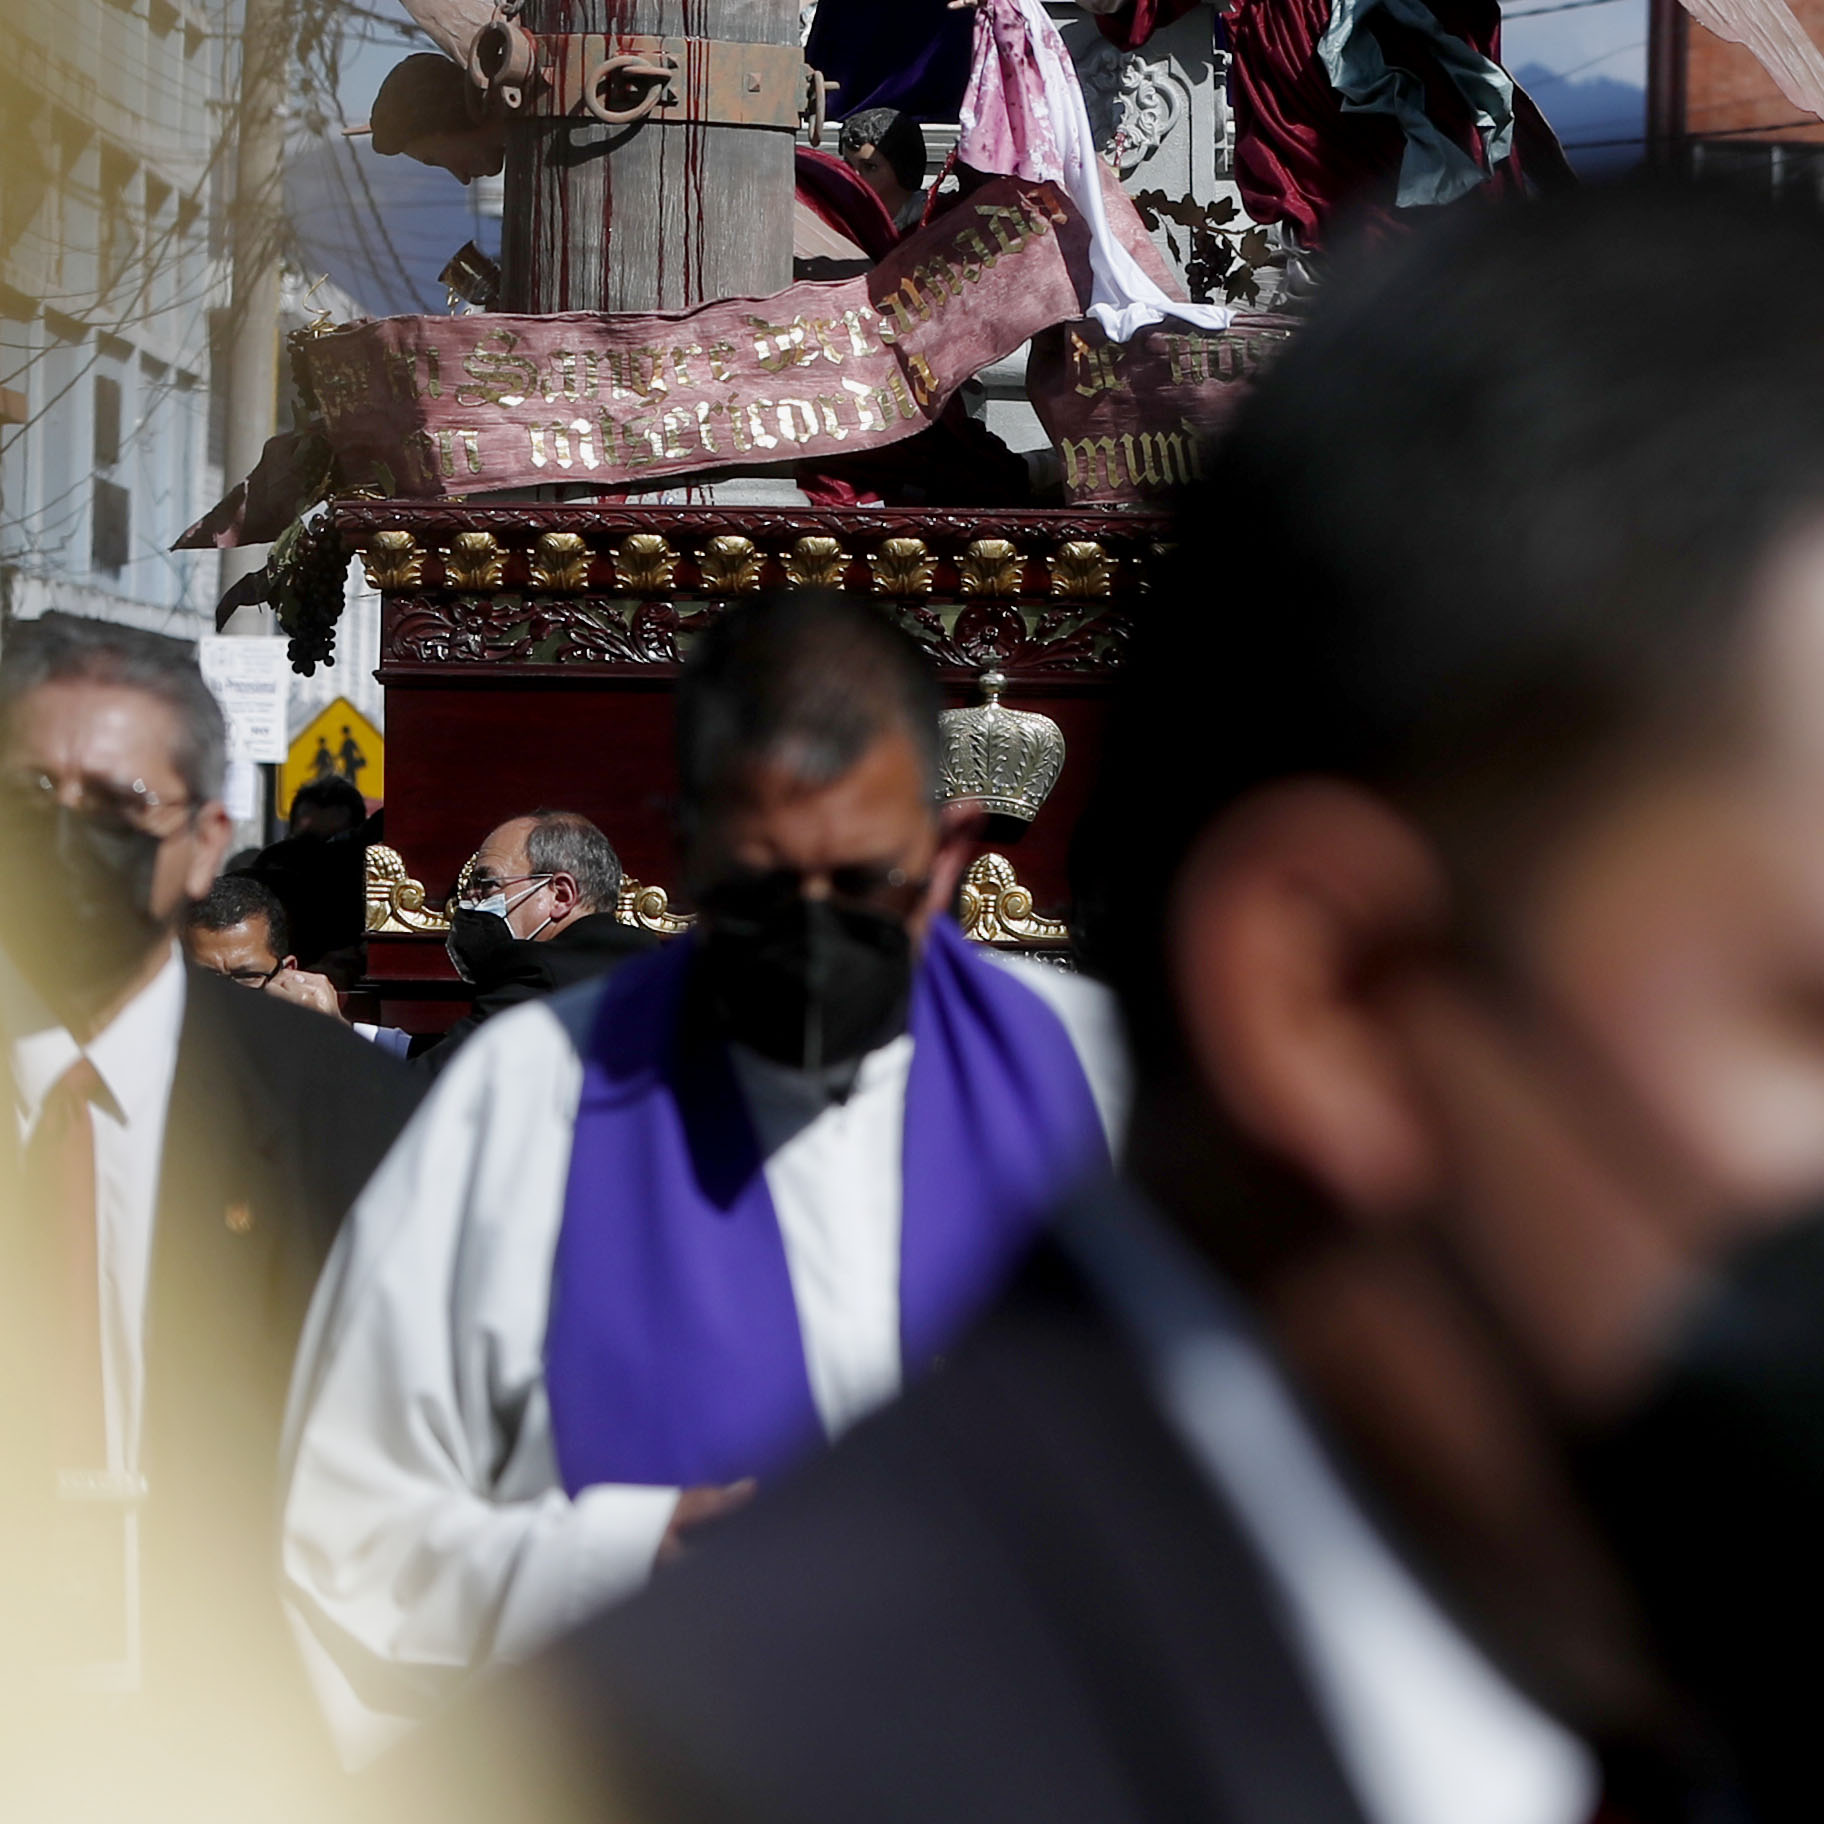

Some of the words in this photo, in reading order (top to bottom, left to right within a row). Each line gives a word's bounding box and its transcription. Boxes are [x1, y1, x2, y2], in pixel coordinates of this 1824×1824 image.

[456, 326, 734, 410] Sangre
[746, 185, 1069, 372] derramada
[528, 351, 940, 471] misericordia
